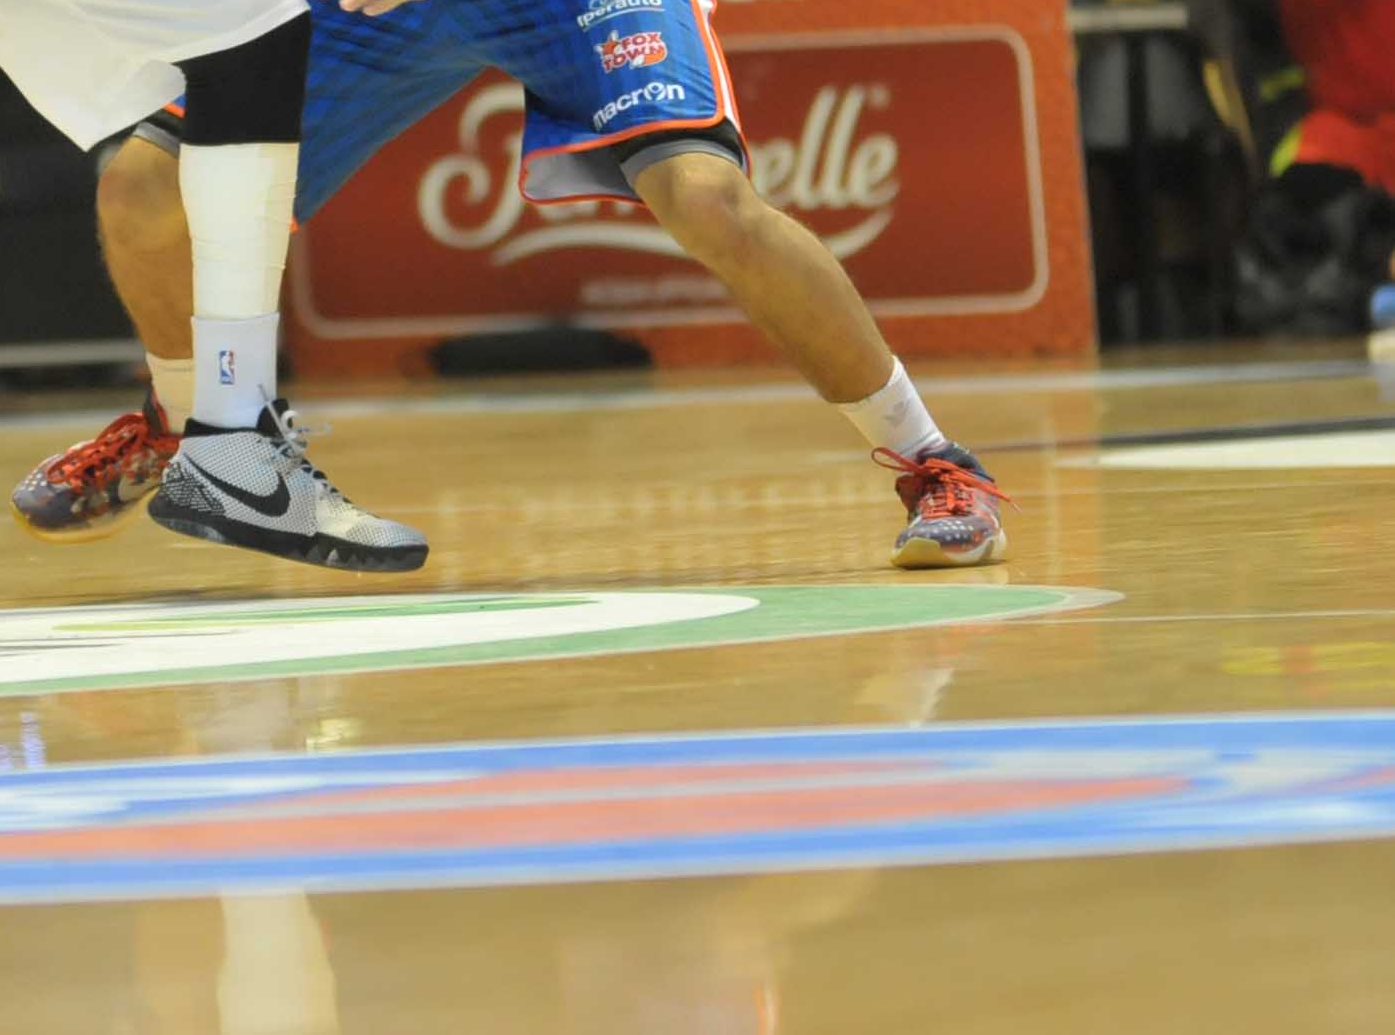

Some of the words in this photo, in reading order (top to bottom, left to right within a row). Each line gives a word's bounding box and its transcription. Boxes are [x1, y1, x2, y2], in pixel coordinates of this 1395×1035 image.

[622, 33, 661, 50] FOX
[602, 44, 664, 72] TOWN
[593, 82, 685, 132] macron
